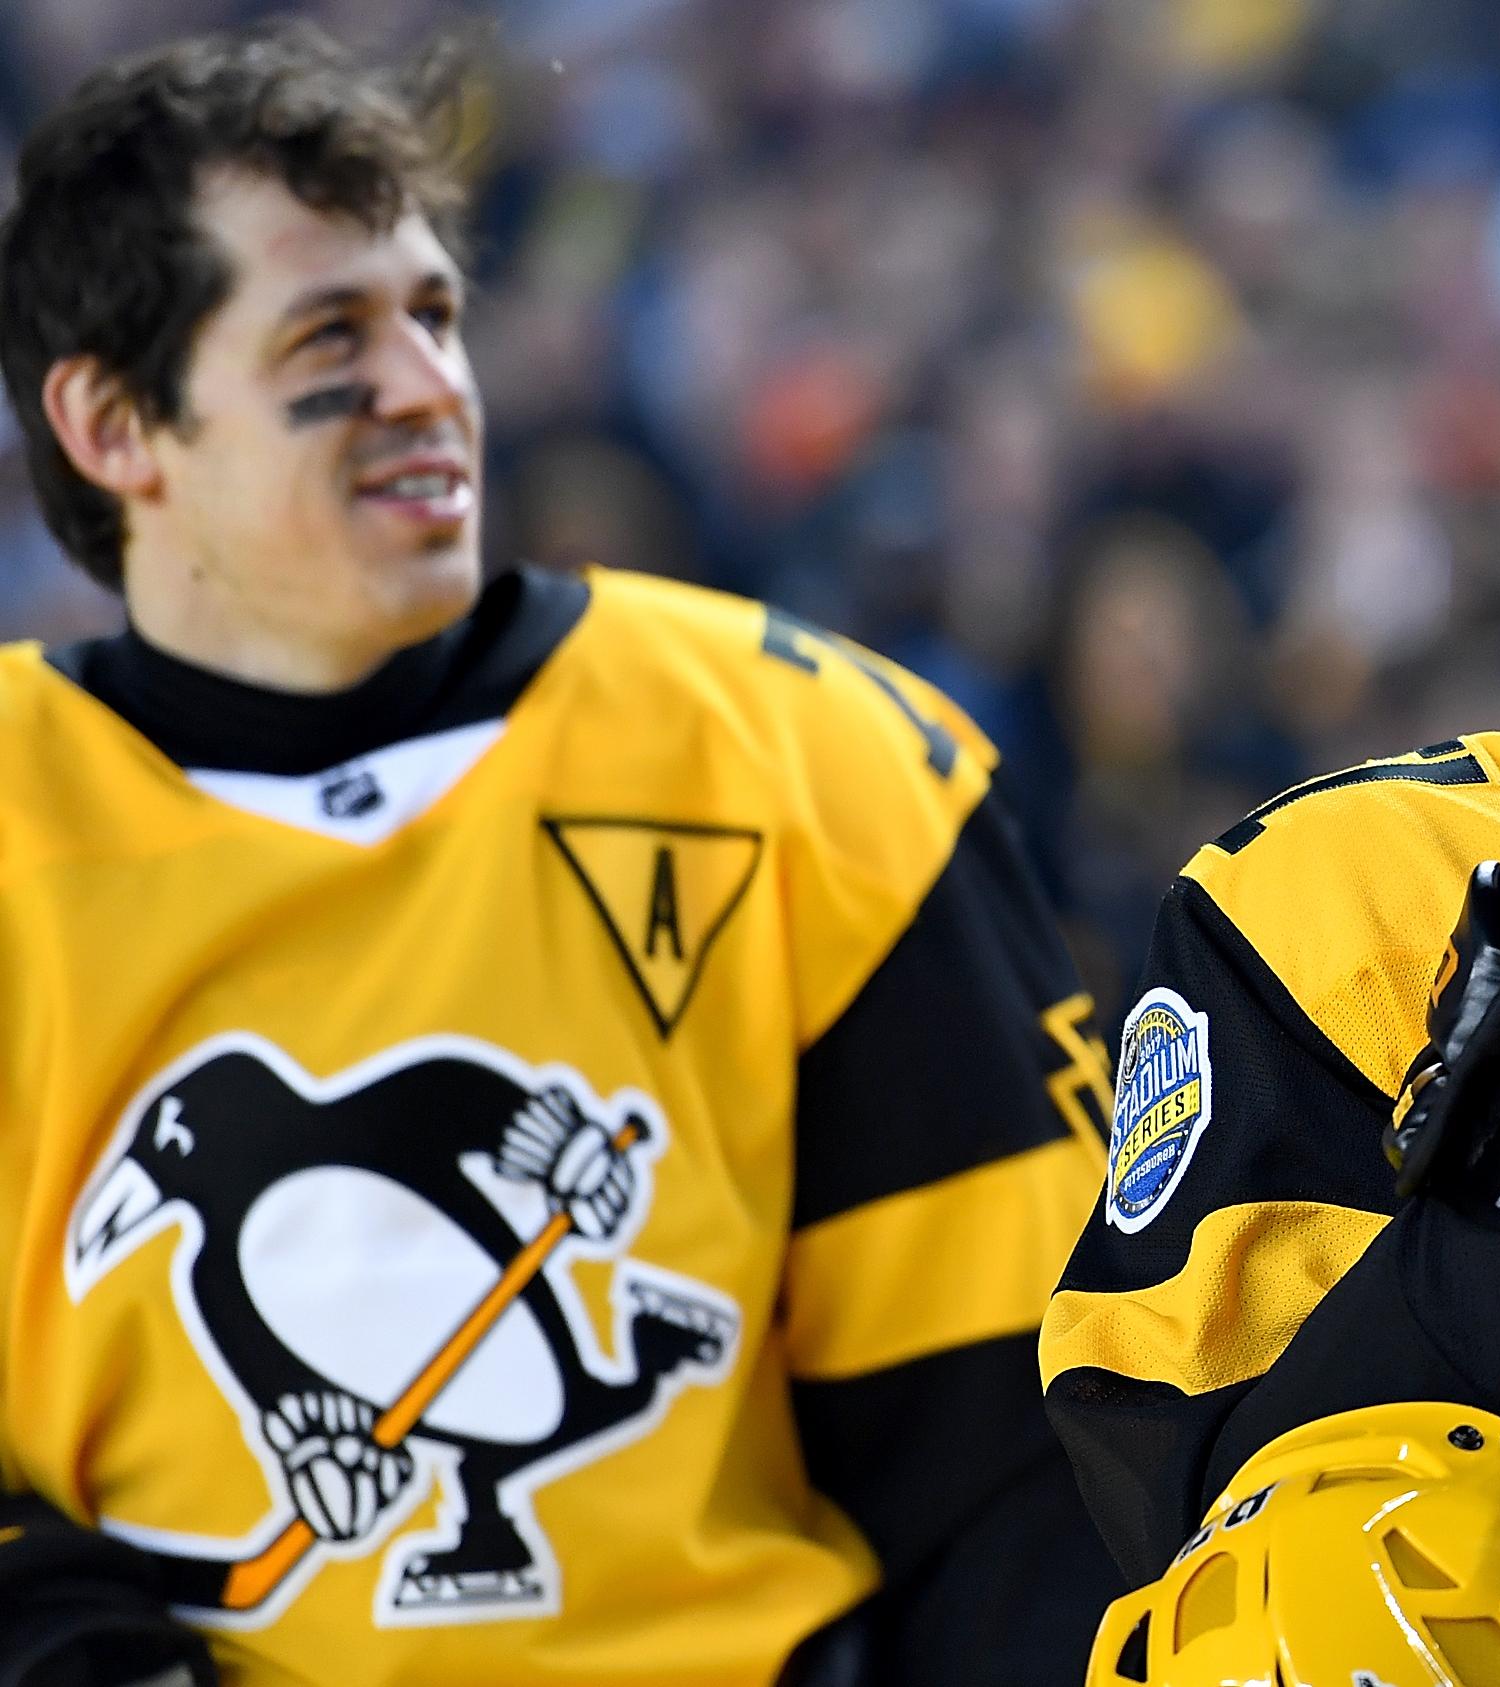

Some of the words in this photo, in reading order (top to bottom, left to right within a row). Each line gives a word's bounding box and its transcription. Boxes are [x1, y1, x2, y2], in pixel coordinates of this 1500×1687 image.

[645, 846, 684, 961] A
[1111, 1031, 1198, 1158] STADIUM
[1124, 1091, 1185, 1167] SERIES
[1123, 1143, 1176, 1191] PITTSBURGH
